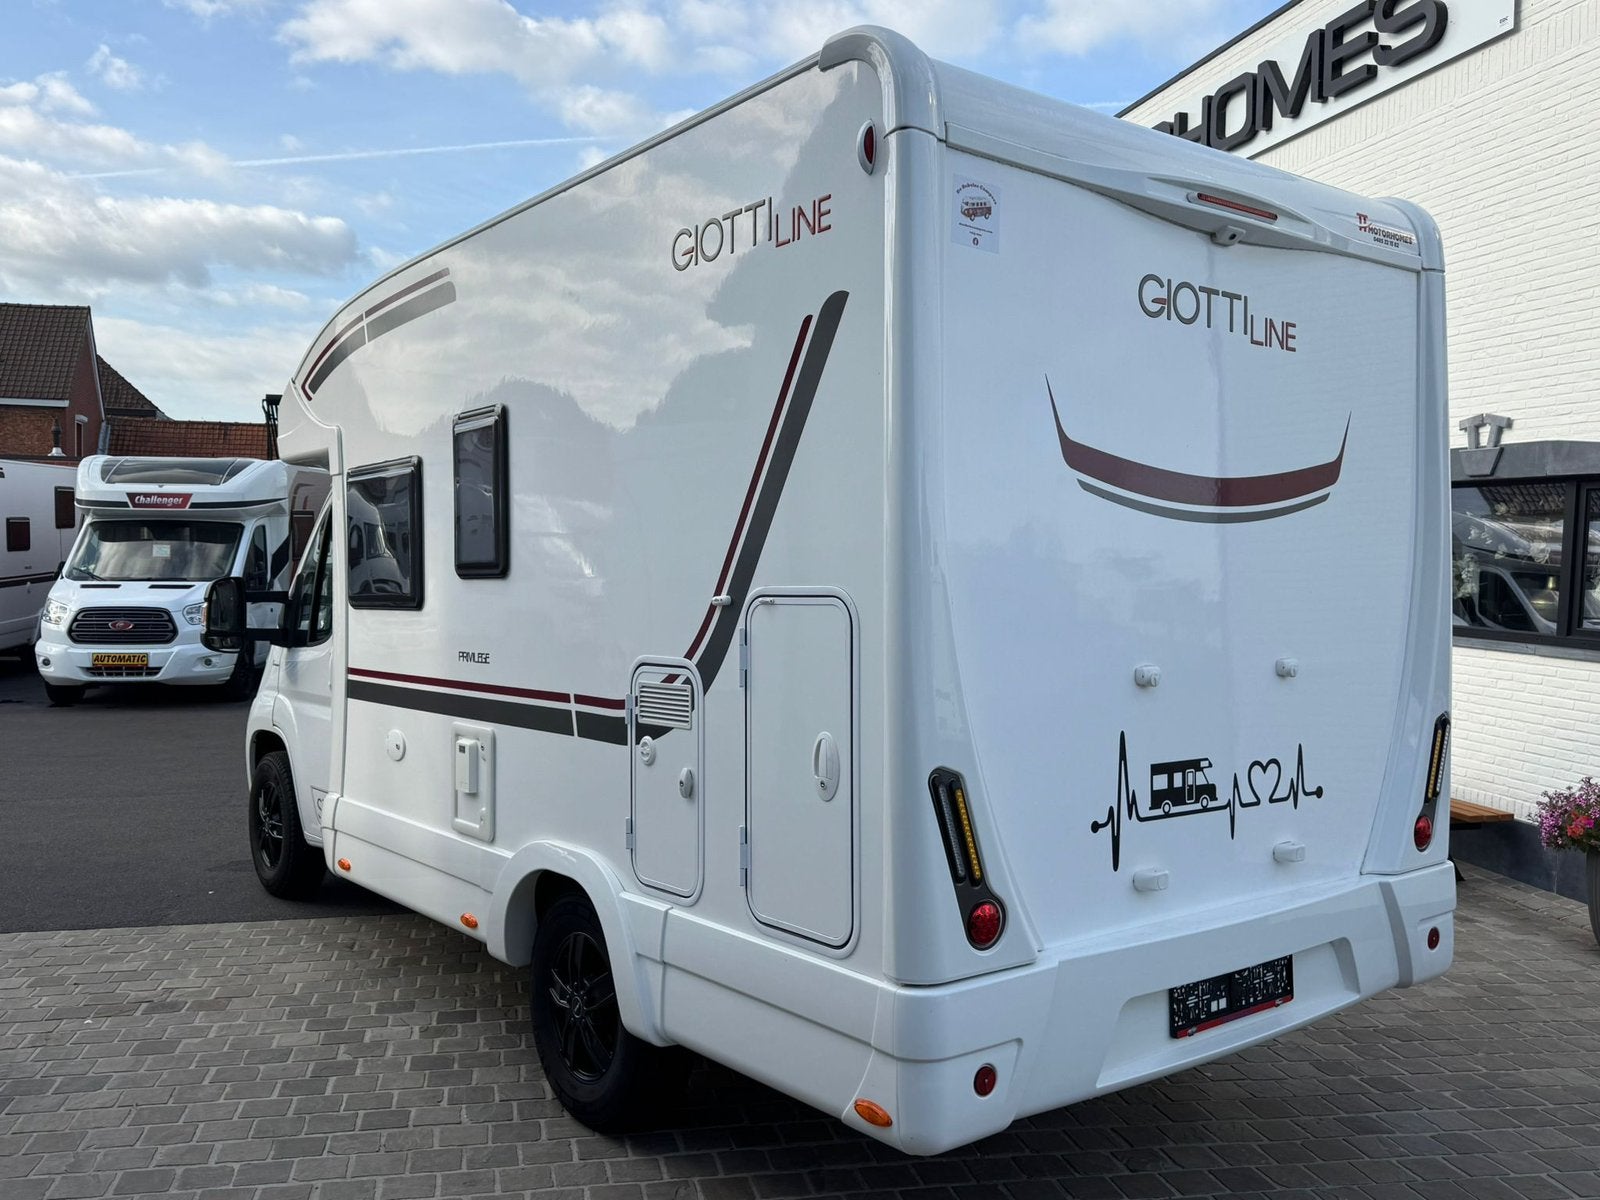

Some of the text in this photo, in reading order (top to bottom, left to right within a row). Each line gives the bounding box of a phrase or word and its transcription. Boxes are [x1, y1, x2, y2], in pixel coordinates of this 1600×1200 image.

[1367, 226, 1413, 245] MOTORHOMES
[134, 494, 184, 507] Challenger
[93, 654, 147, 663] AUTOMATIC
[458, 650, 491, 665] PRIVILEGE
